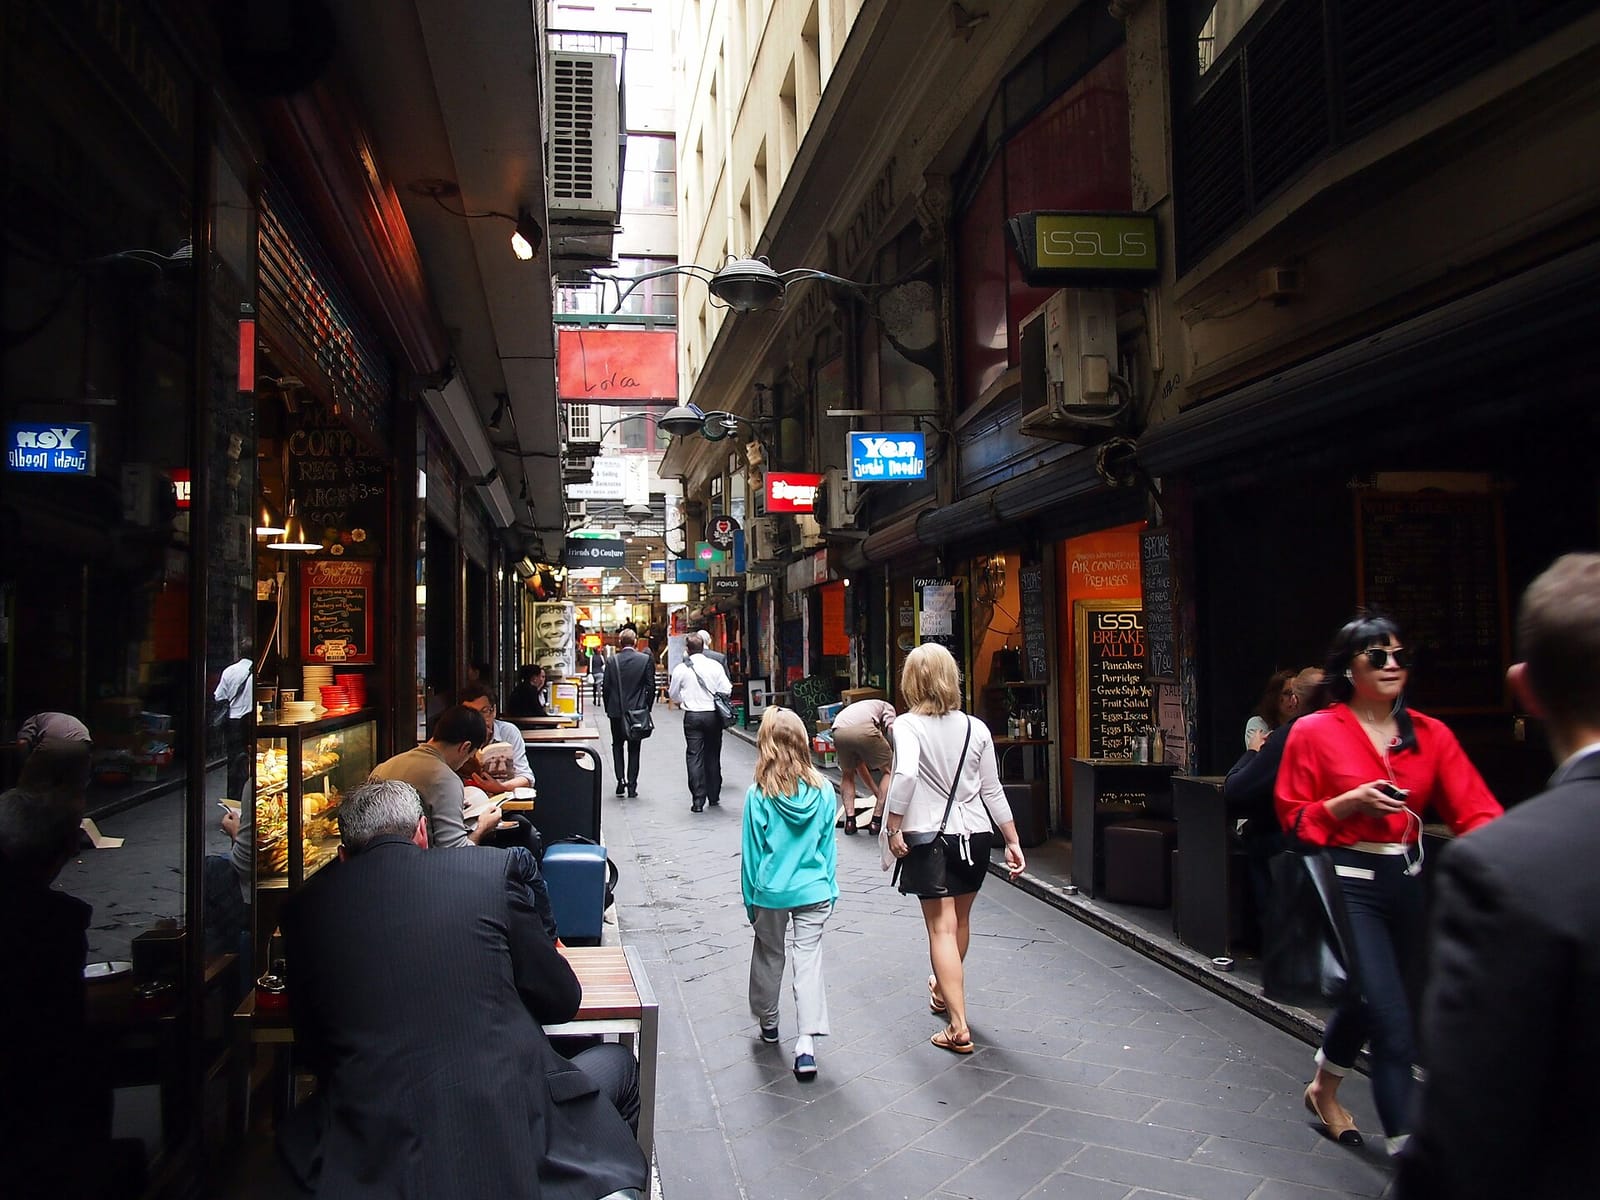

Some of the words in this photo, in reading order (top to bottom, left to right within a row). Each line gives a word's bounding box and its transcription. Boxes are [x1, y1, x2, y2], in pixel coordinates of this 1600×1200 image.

[715, 580, 739, 588] FOKUS
[1101, 644, 1128, 657] ALL
[1102, 661, 1144, 671] Pancakes
[1102, 673, 1141, 685] Porridge
[1097, 685, 1122, 695] Greek
[1102, 699, 1123, 708] Fruit
[1124, 698, 1150, 709] Salad
[1102, 711, 1123, 723] Eggs
[1101, 723, 1122, 735] Eggs
[1102, 735, 1124, 748] Eggs
